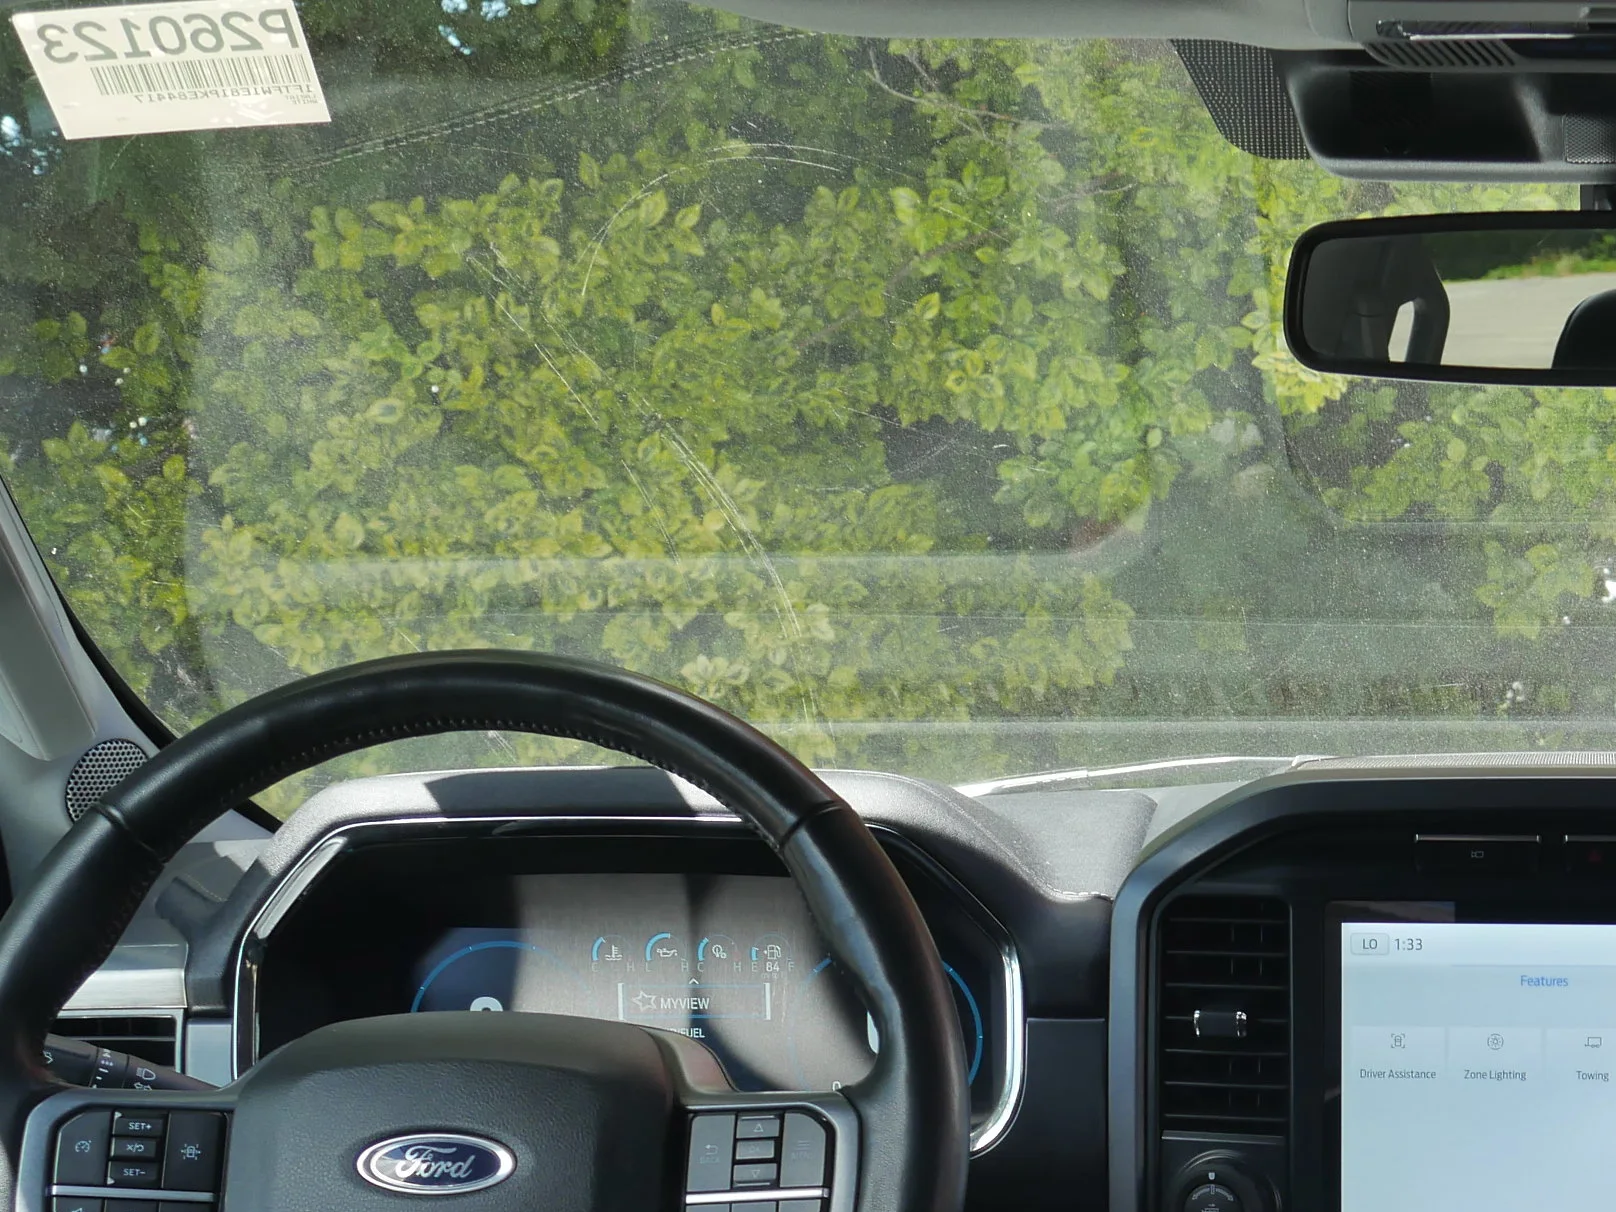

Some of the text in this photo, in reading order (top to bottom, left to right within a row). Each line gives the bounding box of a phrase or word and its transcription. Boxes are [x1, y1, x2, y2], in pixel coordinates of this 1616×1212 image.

[1362, 938, 1378, 950] LO
[1395, 938, 1423, 950] 1:33
[766, 961, 780, 972] 84
[1520, 975, 1569, 987] Features
[660, 997, 710, 1010] MYVIEW
[1359, 1069, 1437, 1080] Driver Assistance
[1464, 1070, 1527, 1082] Zone Lighting
[1576, 1071, 1610, 1082] Towing
[128, 1122, 152, 1130] SET+
[395, 1145, 476, 1179] Ford
